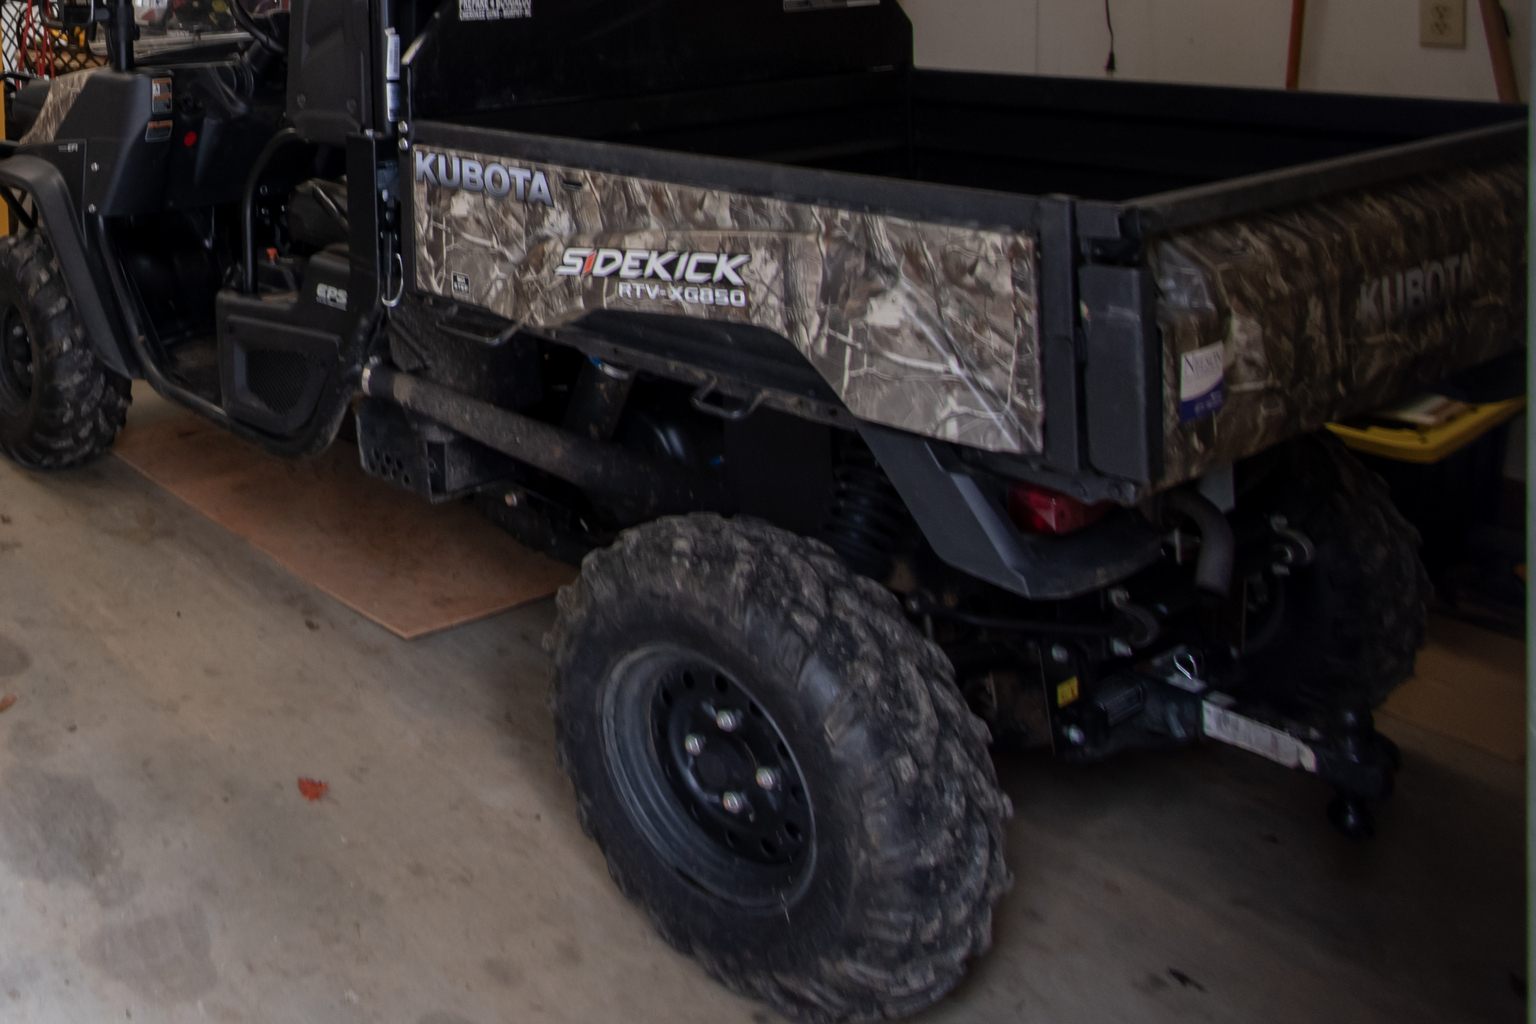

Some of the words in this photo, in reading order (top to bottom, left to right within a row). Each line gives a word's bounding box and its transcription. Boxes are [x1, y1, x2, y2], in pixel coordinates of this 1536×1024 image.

[67, 143, 79, 153] EFI
[415, 151, 554, 207] KUBOTA
[554, 247, 751, 286] SIDEKICK
[316, 283, 348, 304] EPS
[618, 281, 747, 308] RTV-XG850
[1360, 252, 1474, 323] KUBOTA
